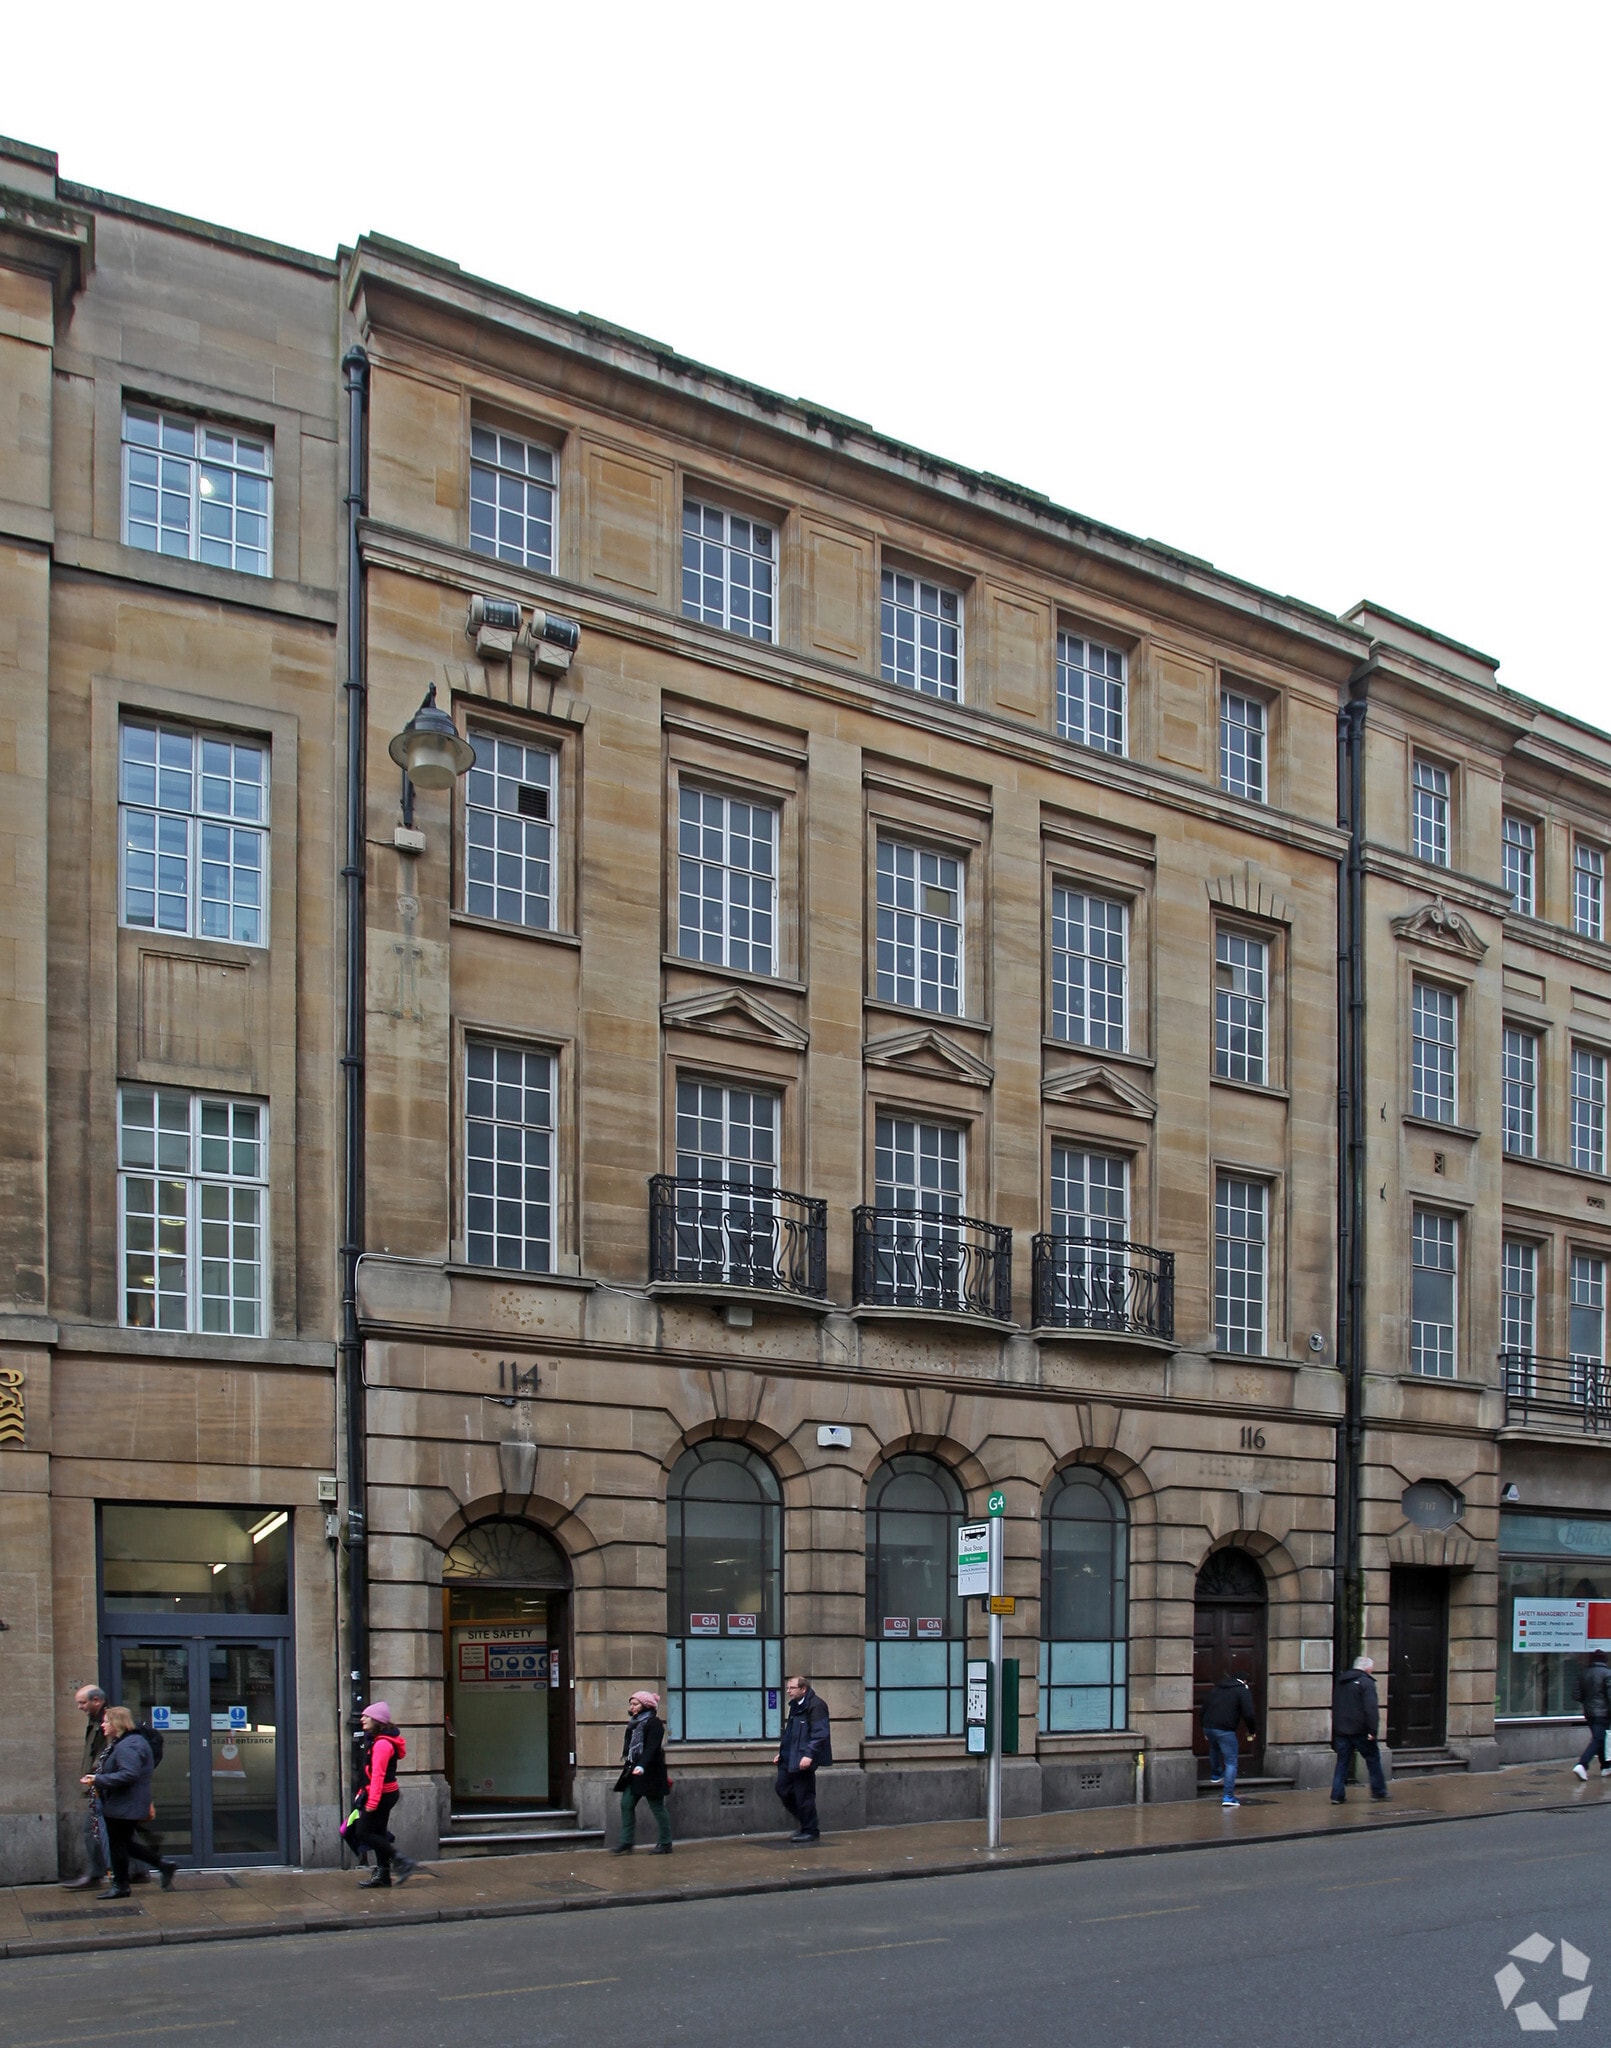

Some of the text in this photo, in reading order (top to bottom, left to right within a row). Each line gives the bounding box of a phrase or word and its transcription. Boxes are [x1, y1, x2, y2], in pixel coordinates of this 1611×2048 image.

[499, 1360, 542, 1391] 114
[1240, 1426, 1266, 1449] 116
[988, 1495, 1004, 1510] G4
[702, 1616, 717, 1626] GA
[739, 1617, 754, 1626] GA
[893, 1620, 907, 1629] GA
[926, 1620, 940, 1629] GA
[468, 1628, 533, 1640] SITE SAFETY
